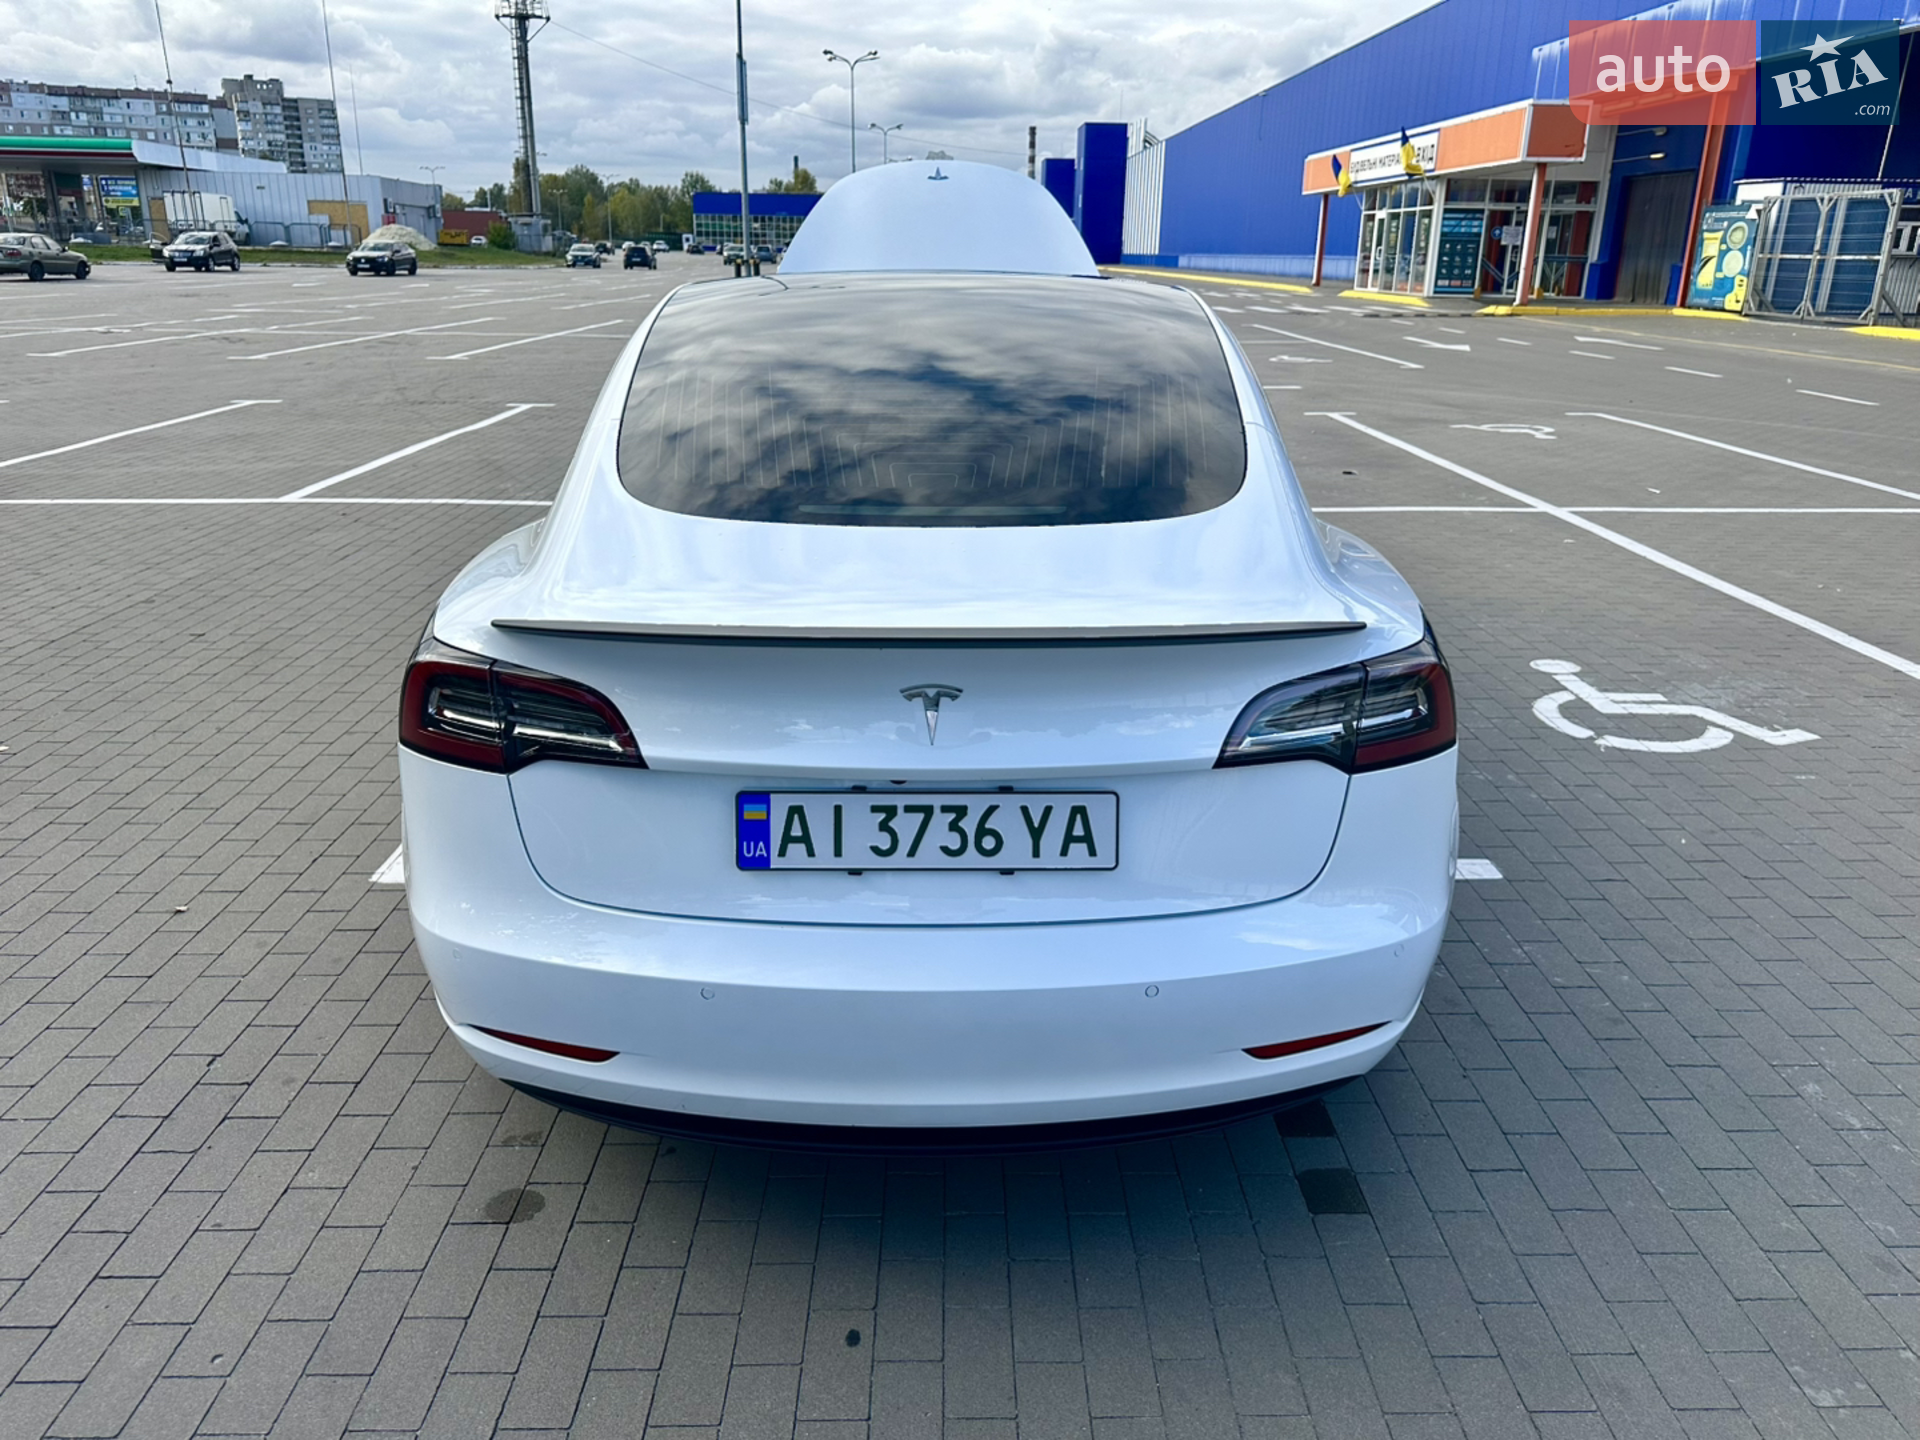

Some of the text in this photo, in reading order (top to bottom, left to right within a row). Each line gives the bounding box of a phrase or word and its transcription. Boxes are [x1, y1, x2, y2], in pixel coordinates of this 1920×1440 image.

[1416, 144, 1435, 164] ВХІД
[777, 804, 1098, 859] AI 3736 YA
[743, 841, 767, 858] UA
